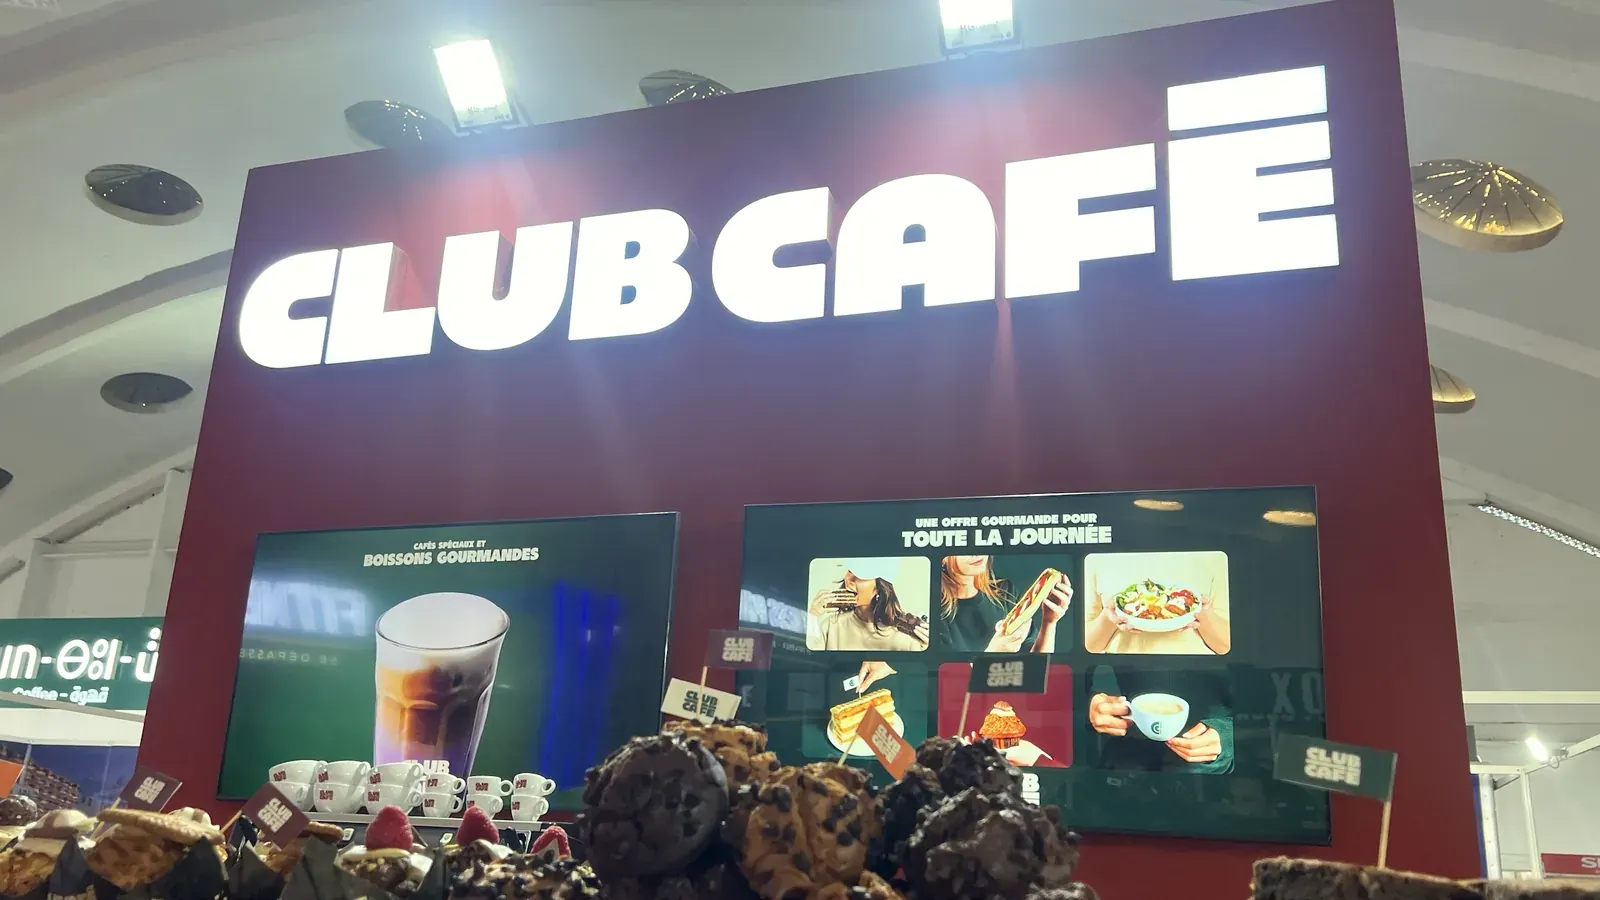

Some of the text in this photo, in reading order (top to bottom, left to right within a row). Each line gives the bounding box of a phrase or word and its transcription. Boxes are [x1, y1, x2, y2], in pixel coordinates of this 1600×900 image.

[239, 65, 1340, 368] CLUB CAFÉ
[915, 513, 1098, 528] UNE OFFRE GOURMANDE POUR
[413, 539, 487, 550] CAFÉS SPÉCIAUX ET
[901, 523, 1112, 548] TOUTE LA JOURNÉE
[363, 547, 540, 567] BOISSONS GOURMANDES
[724, 637, 754, 649] CLUB
[989, 661, 1024, 673] CLUB
[686, 690, 718, 706] CLUB
[877, 724, 901, 752] CLUB
[1305, 746, 1361, 768] CLUB
[269, 797, 293, 821] CLUB
